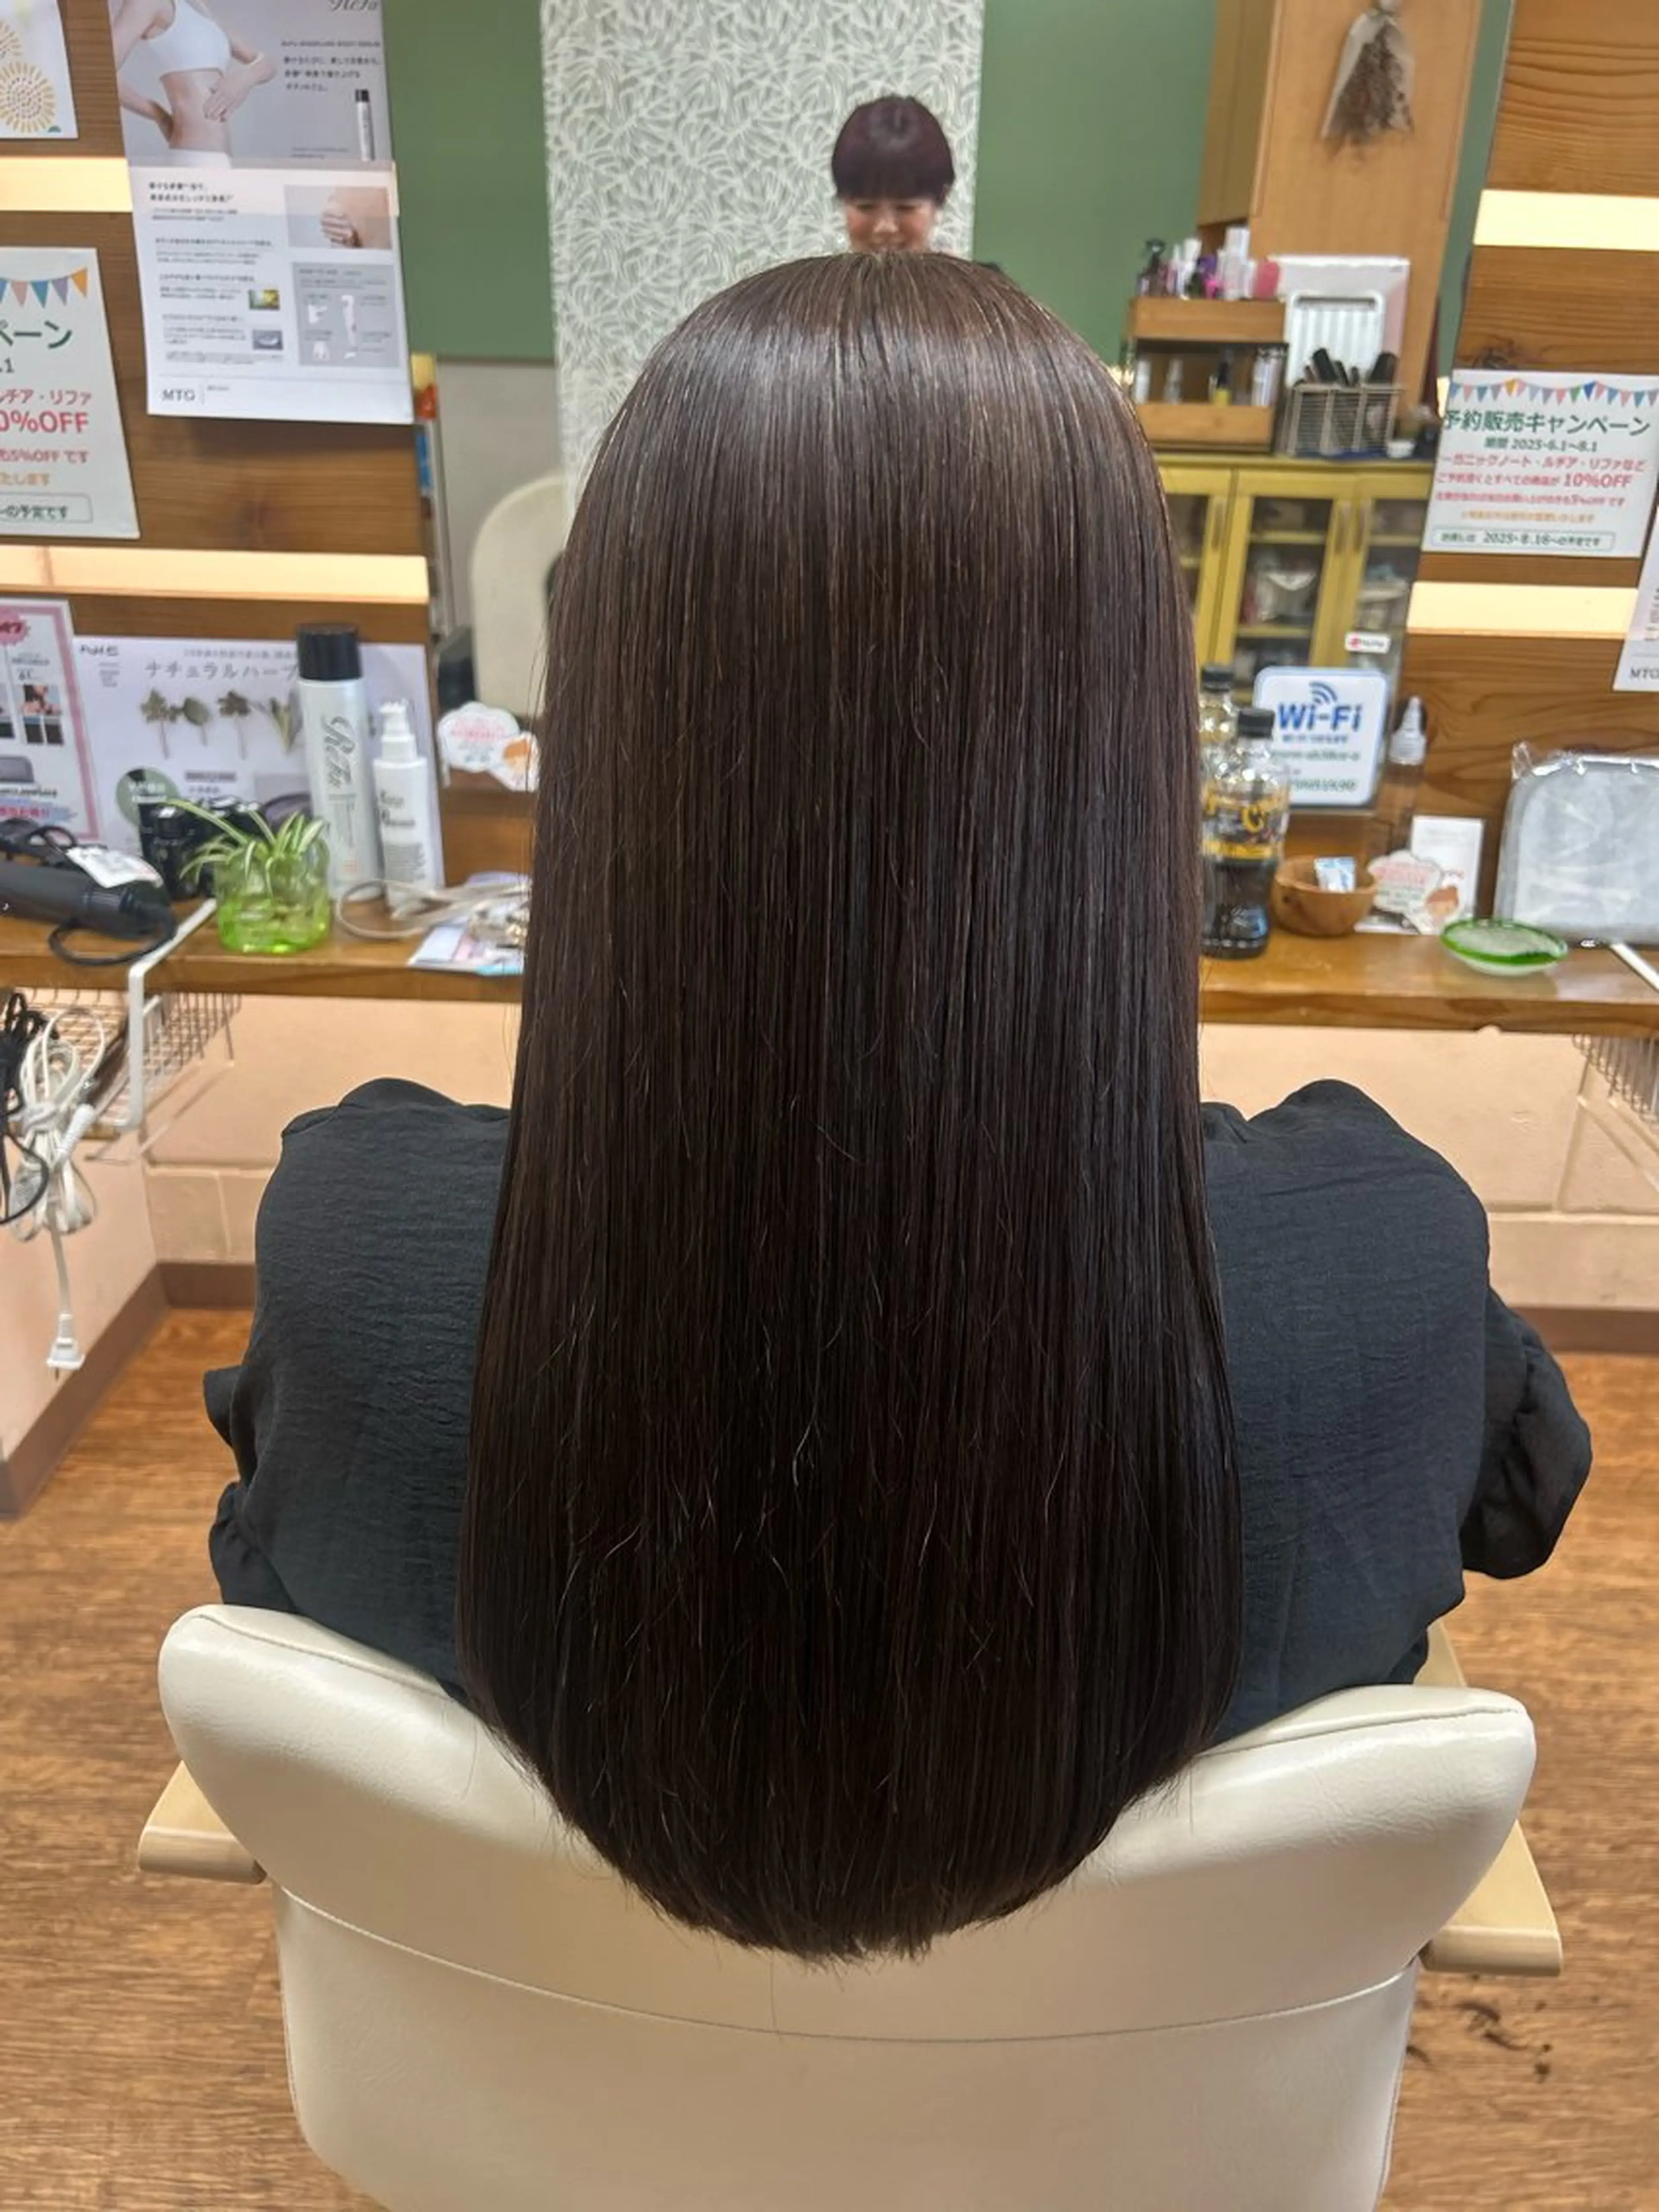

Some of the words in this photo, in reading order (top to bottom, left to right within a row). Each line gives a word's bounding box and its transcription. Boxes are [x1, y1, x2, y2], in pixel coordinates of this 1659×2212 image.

[0, 388, 92, 405] チア・リファ
[162, 388, 196, 401] MTG
[1445, 410, 1650, 436] 予約販売キャンペーン
[1563, 473, 1633, 488] 10%OFF
[1278, 704, 1363, 732] Wi-Fi
